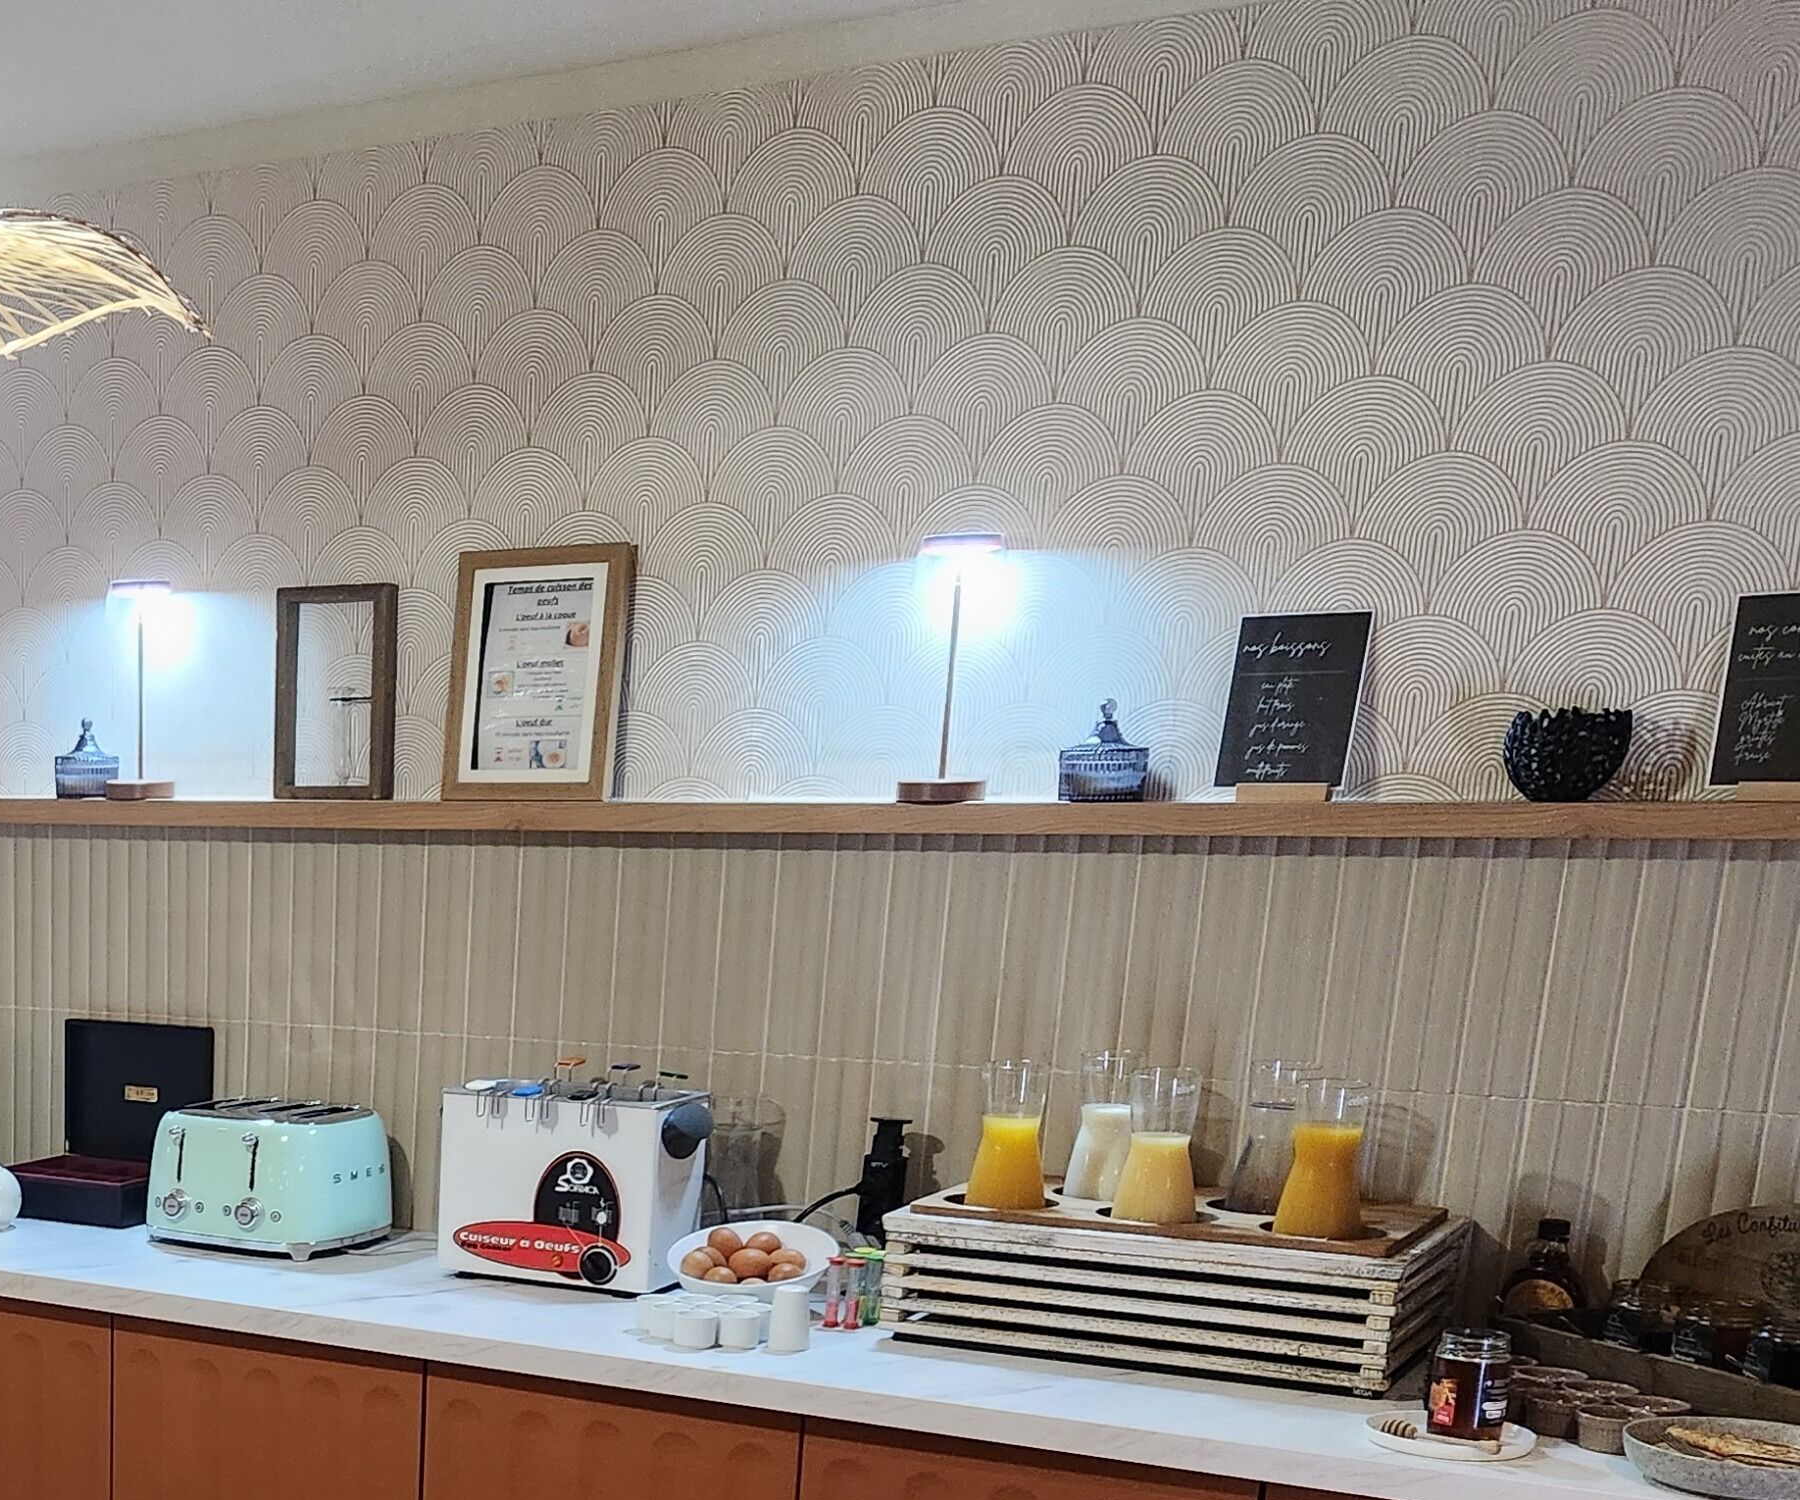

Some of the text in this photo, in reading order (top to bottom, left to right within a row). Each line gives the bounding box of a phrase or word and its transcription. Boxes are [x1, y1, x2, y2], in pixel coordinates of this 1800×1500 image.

[508, 581, 594, 595] Temps de cuisson des
[1243, 643, 1269, 659] nos
[459, 1231, 517, 1247] Cuiseur
